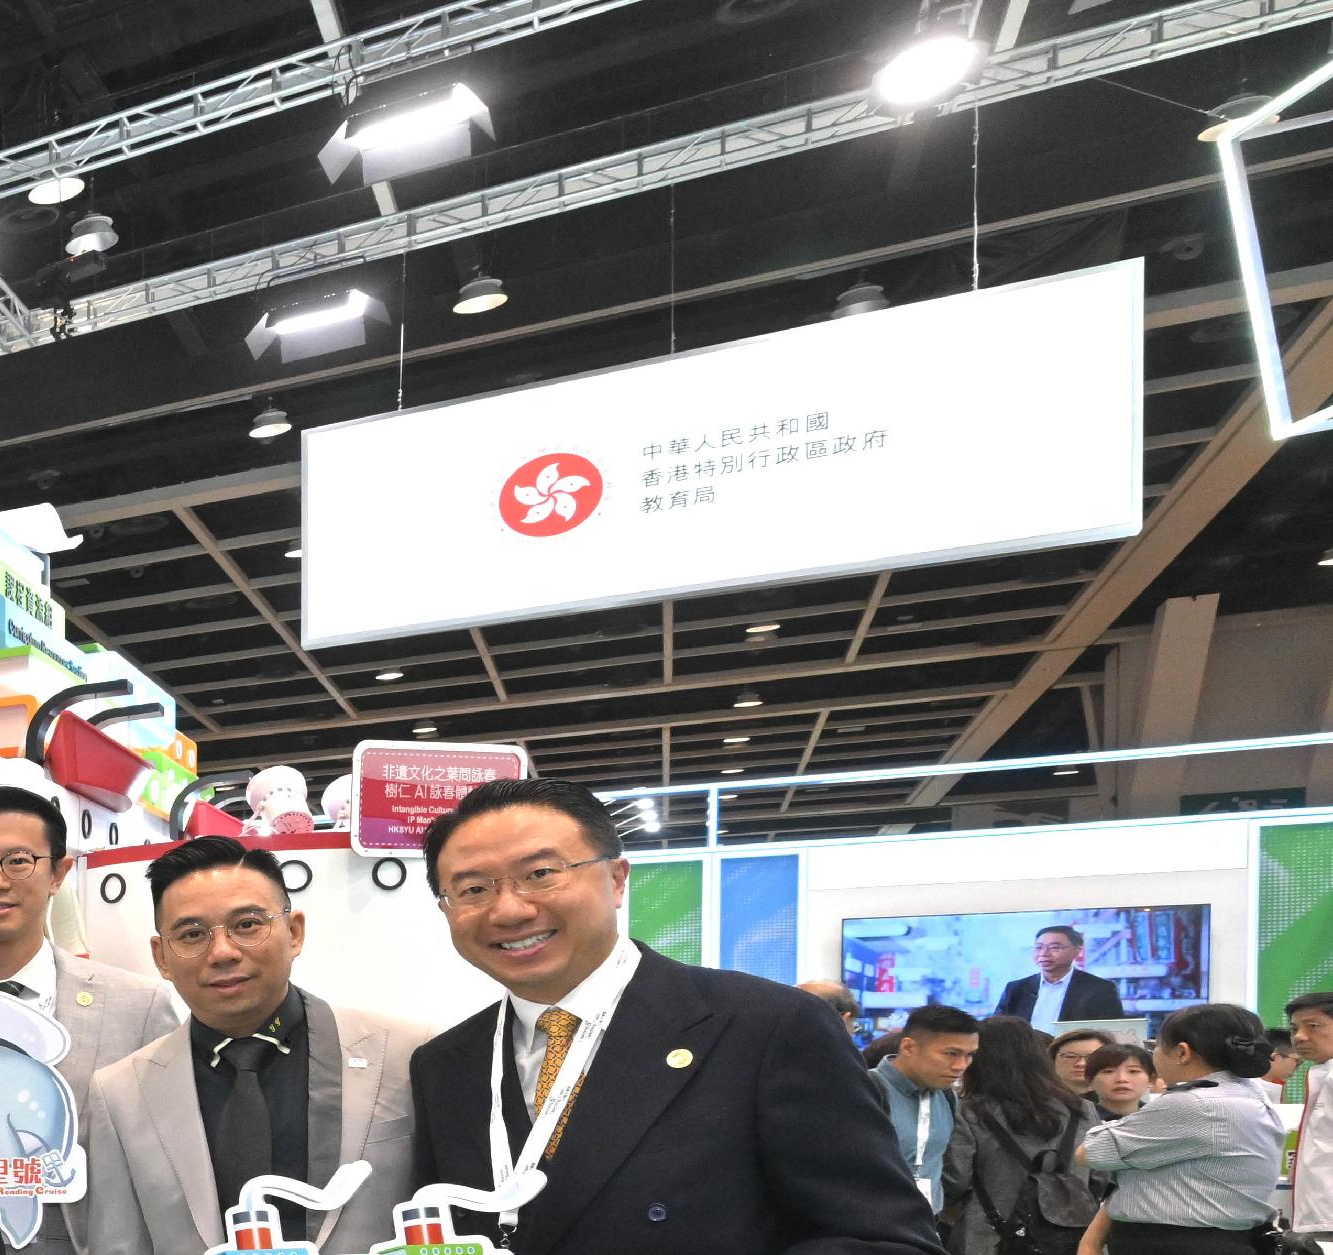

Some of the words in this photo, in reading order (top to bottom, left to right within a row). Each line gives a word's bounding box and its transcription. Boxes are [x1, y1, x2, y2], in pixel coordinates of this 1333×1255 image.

[642, 411, 829, 461] 中華人民共和國
[641, 429, 888, 488] 香港特別行政區政府
[640, 485, 715, 514] 教育局
[384, 782, 412, 799] 樹仁
[414, 783, 427, 799] AI
[391, 804, 428, 815] Intangible
[388, 825, 415, 835] HKSYU
[35, 1186, 67, 1196] Cruise
